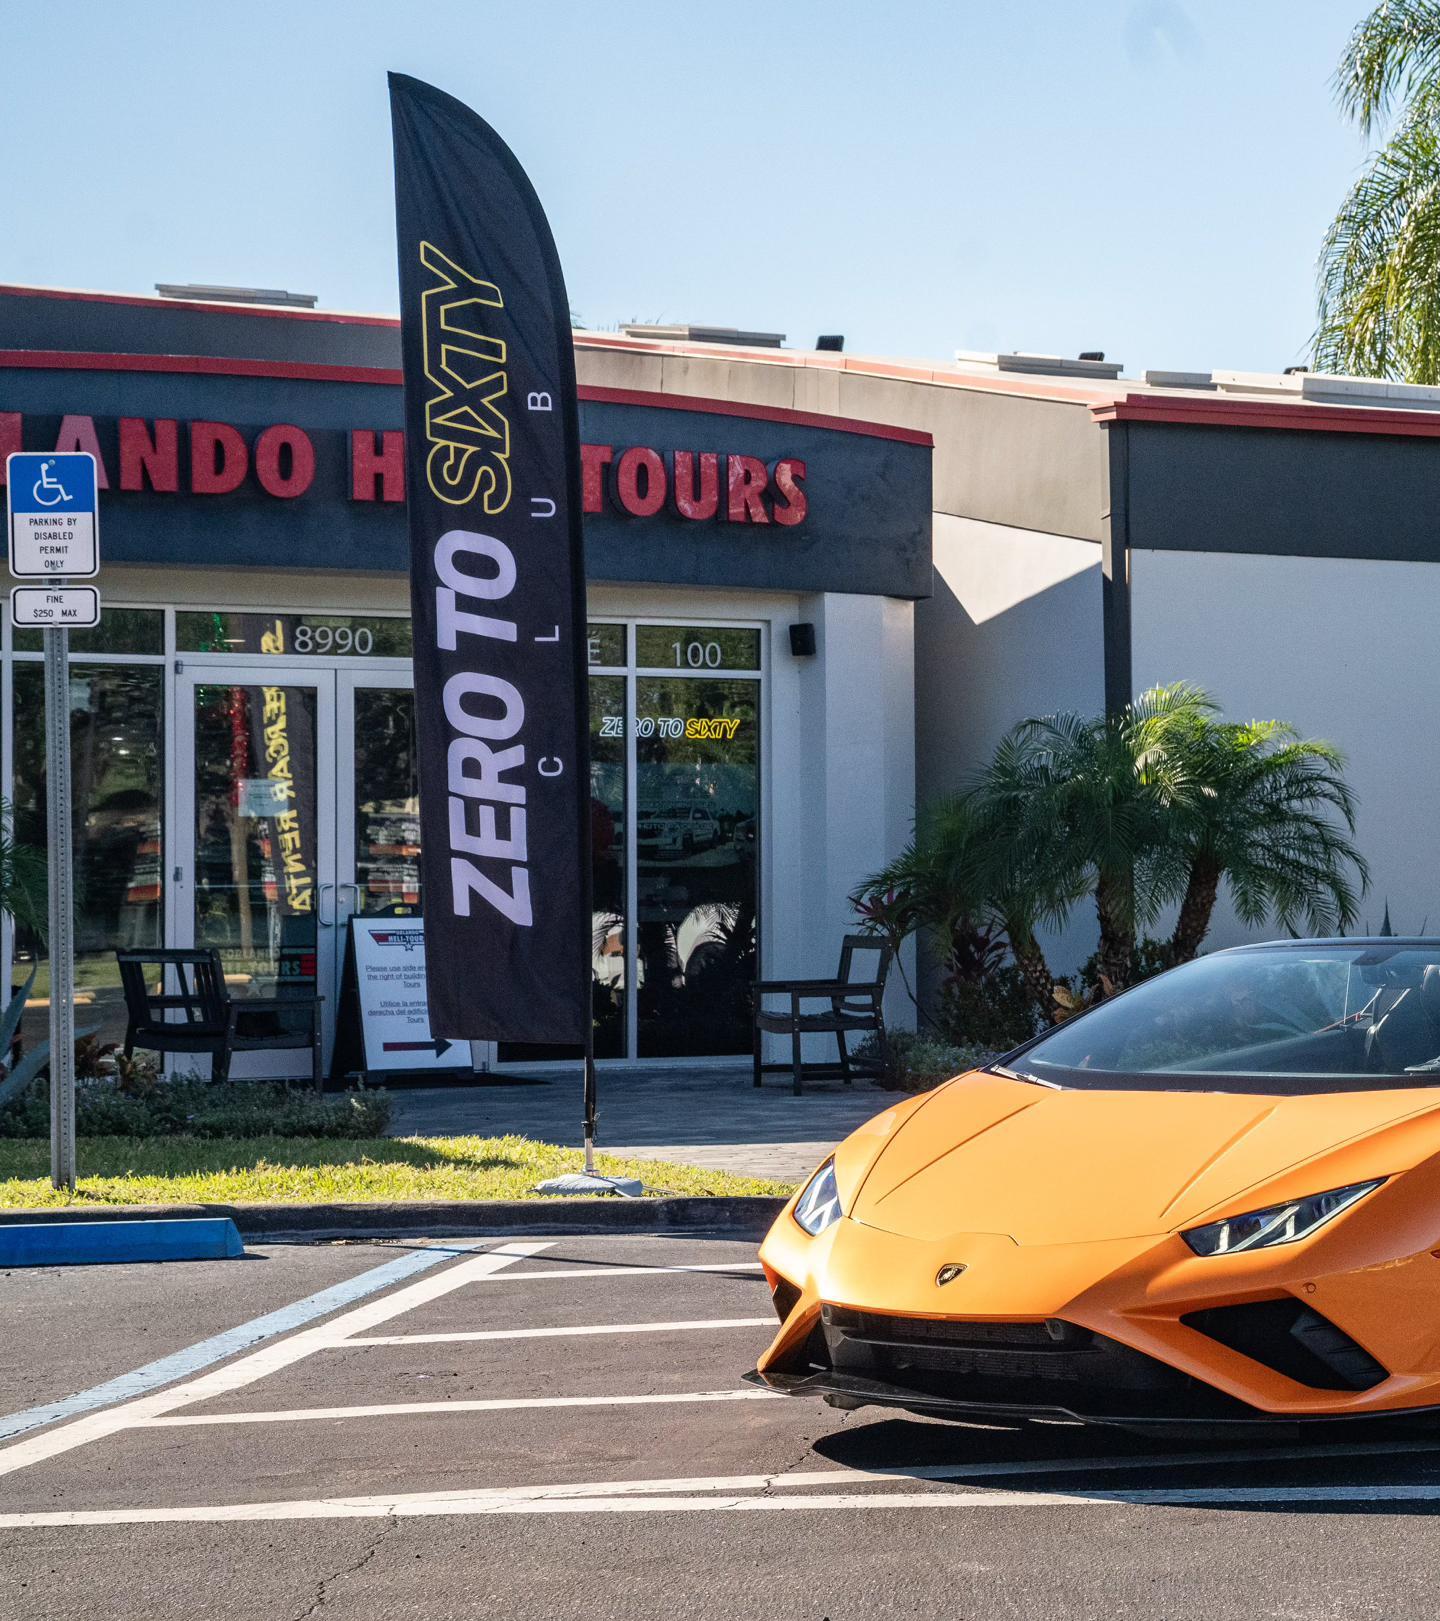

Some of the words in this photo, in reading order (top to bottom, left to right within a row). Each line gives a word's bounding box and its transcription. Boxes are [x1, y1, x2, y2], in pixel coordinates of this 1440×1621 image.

[420, 240, 511, 514] SIXTY
[29, 518, 63, 526] PARKING
[67, 518, 77, 526] BY
[34, 532, 73, 540] DISABLED
[40, 546, 68, 554] PERMIT
[44, 560, 64, 568] ONLY
[434, 529, 517, 652] TO
[46, 595, 64, 603] FINE
[33, 609, 53, 618] $250
[61, 609, 77, 617] MAX
[294, 625, 373, 654] 8990
[672, 642, 721, 667] 100
[658, 717, 684, 738] TO
[685, 718, 741, 739] SIXTY
[442, 671, 533, 927] ZERO
